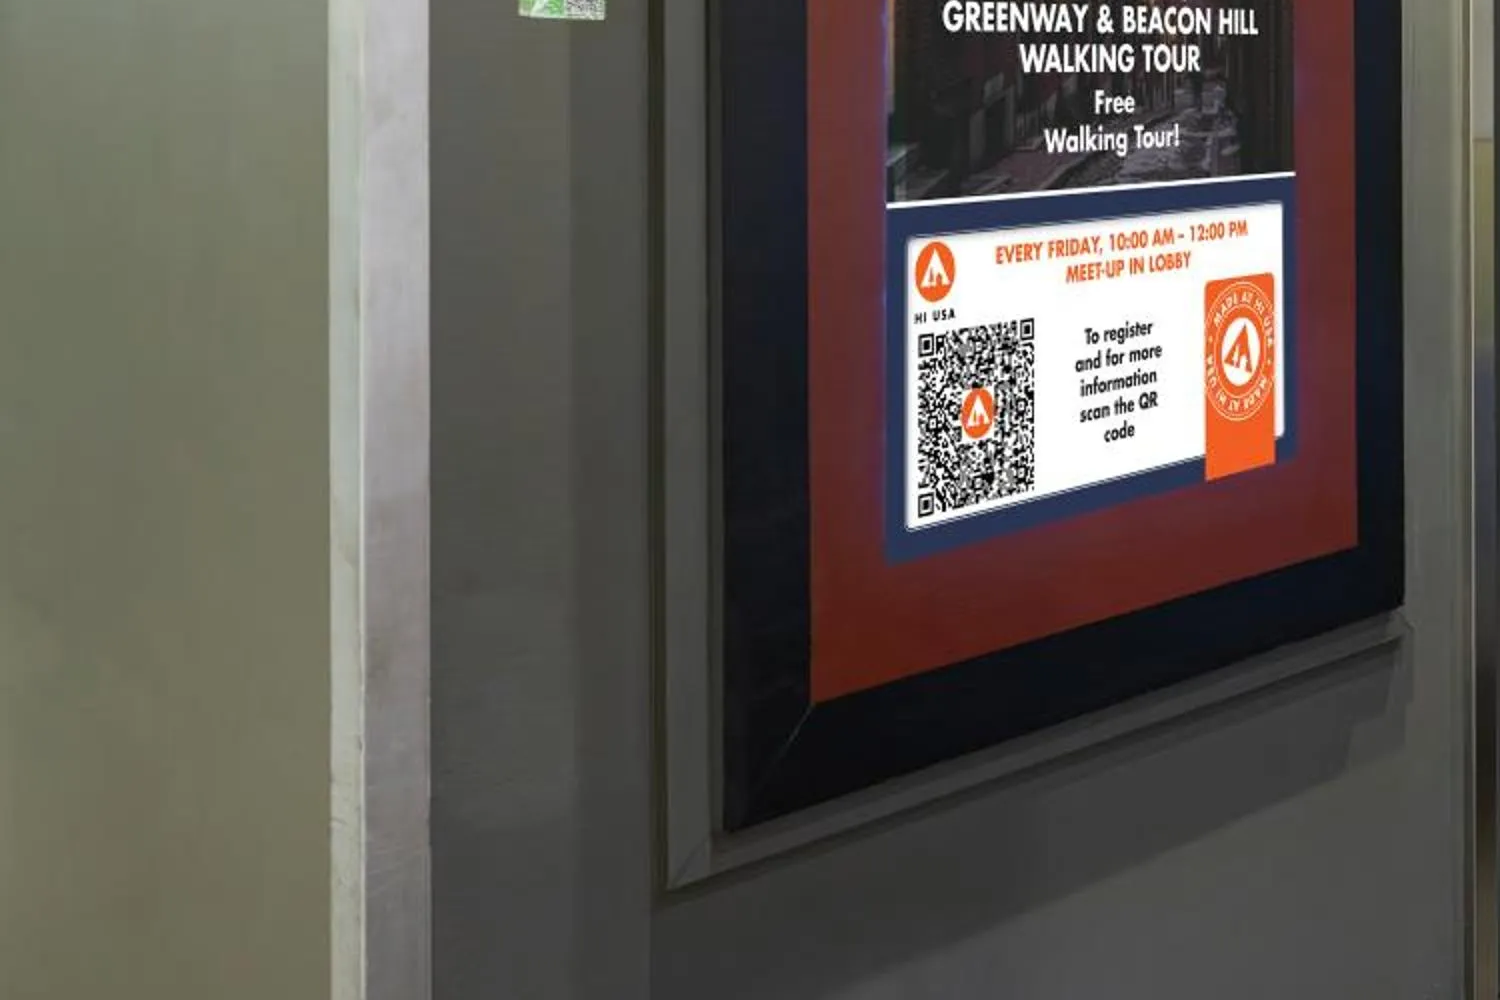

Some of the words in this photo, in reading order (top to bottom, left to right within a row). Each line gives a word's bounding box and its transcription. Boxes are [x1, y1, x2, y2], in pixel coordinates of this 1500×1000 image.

[942, 0, 1089, 33] GREENWAY
[1097, 4, 1114, 34] &
[1122, 5, 1211, 36] BEACON
[1218, 8, 1259, 36] HILL
[1019, 43, 1135, 73] WALKING
[1143, 44, 1201, 73] TOUR
[1094, 90, 1136, 114] Free
[1044, 125, 1128, 157] Walking
[1134, 124, 1180, 150] Tour!
[995, 241, 1043, 265] EVERY
[1047, 235, 1104, 259] FRIDAY,
[1109, 229, 1149, 252] 10:00
[1151, 227, 1174, 247] AM
[1189, 222, 1225, 242] 12:00
[1228, 219, 1249, 239] PM
[1065, 258, 1125, 284] MEET-UP
[1129, 257, 1145, 275] IN
[1149, 251, 1192, 273] LOBBY
[913, 312, 927, 324] HI
[932, 308, 956, 322] USA
[1084, 327, 1100, 345] To
[1103, 321, 1153, 345] register
[1075, 349, 1101, 373] and
[1105, 347, 1125, 367] for
[1129, 345, 1162, 363] more
[1080, 368, 1158, 397] information
[1080, 405, 1111, 423] scan
[1114, 396, 1135, 415] the
[1138, 391, 1158, 411] QR
[1104, 419, 1135, 443] code
